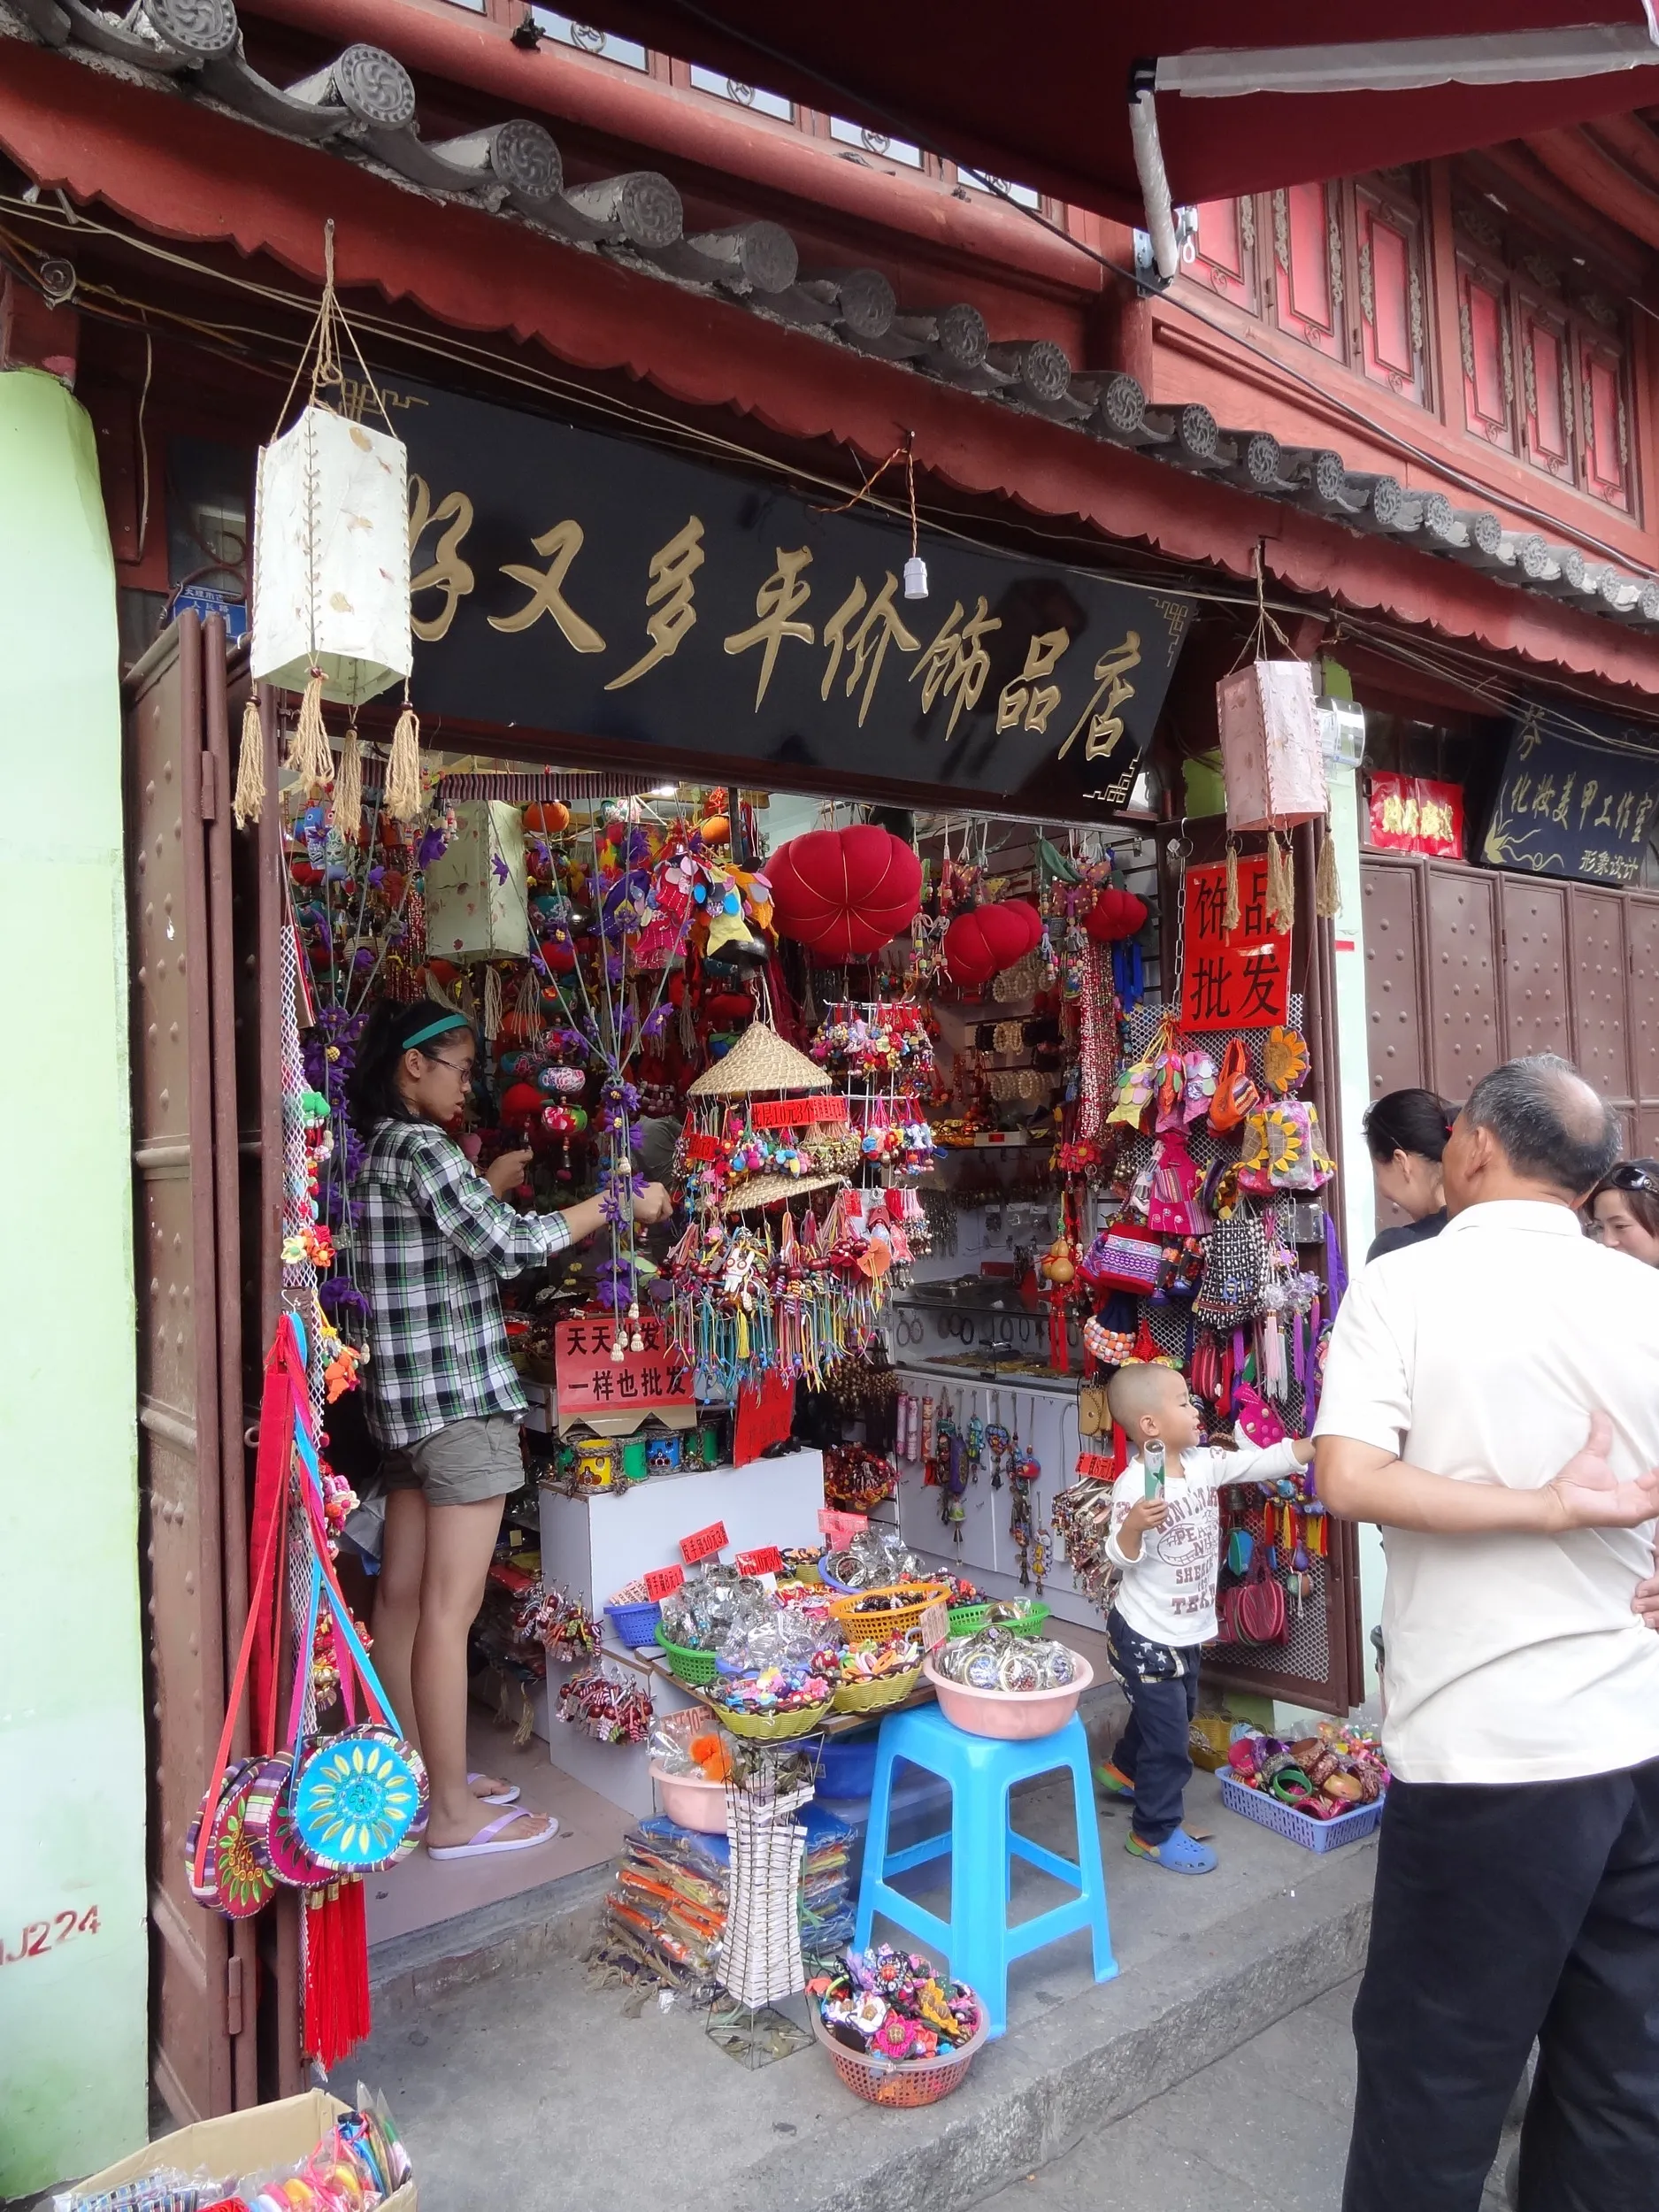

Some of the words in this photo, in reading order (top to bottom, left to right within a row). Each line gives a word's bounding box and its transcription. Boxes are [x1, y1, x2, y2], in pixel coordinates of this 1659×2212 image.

[1510, 772, 1653, 843] 化妆美甲工作室
[1578, 849, 1639, 880] 形象设计
[1190, 954, 1281, 1020] 批发
[568, 1366, 686, 1402] 一样也批发
